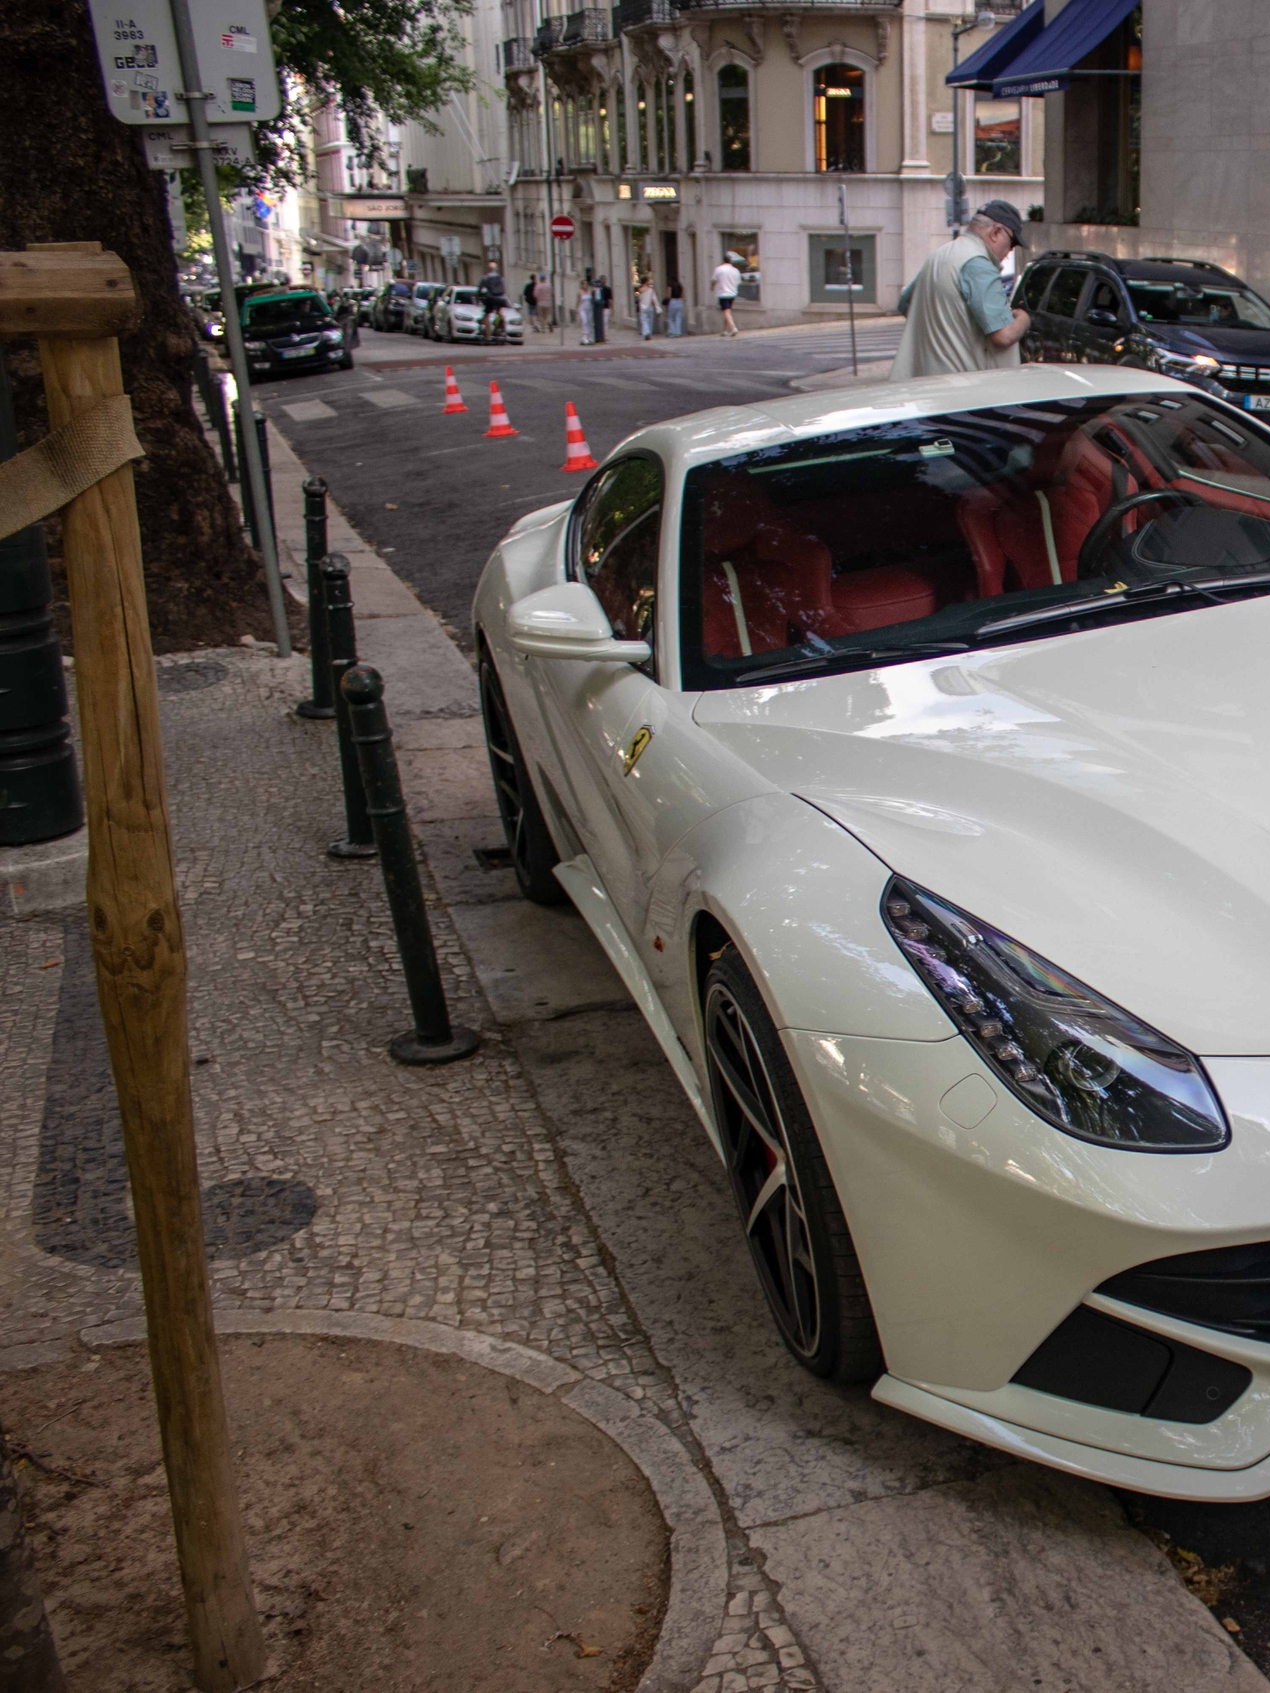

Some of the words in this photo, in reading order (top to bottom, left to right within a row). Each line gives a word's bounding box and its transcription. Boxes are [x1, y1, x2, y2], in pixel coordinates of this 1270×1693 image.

[115, 19, 137, 29] II-A
[114, 30, 145, 40] 3983
[229, 25, 250, 35] CML
[1029, 79, 1059, 92] LIBERDADE
[149, 132, 174, 141] CML
[643, 186, 677, 198] ZEGNA
